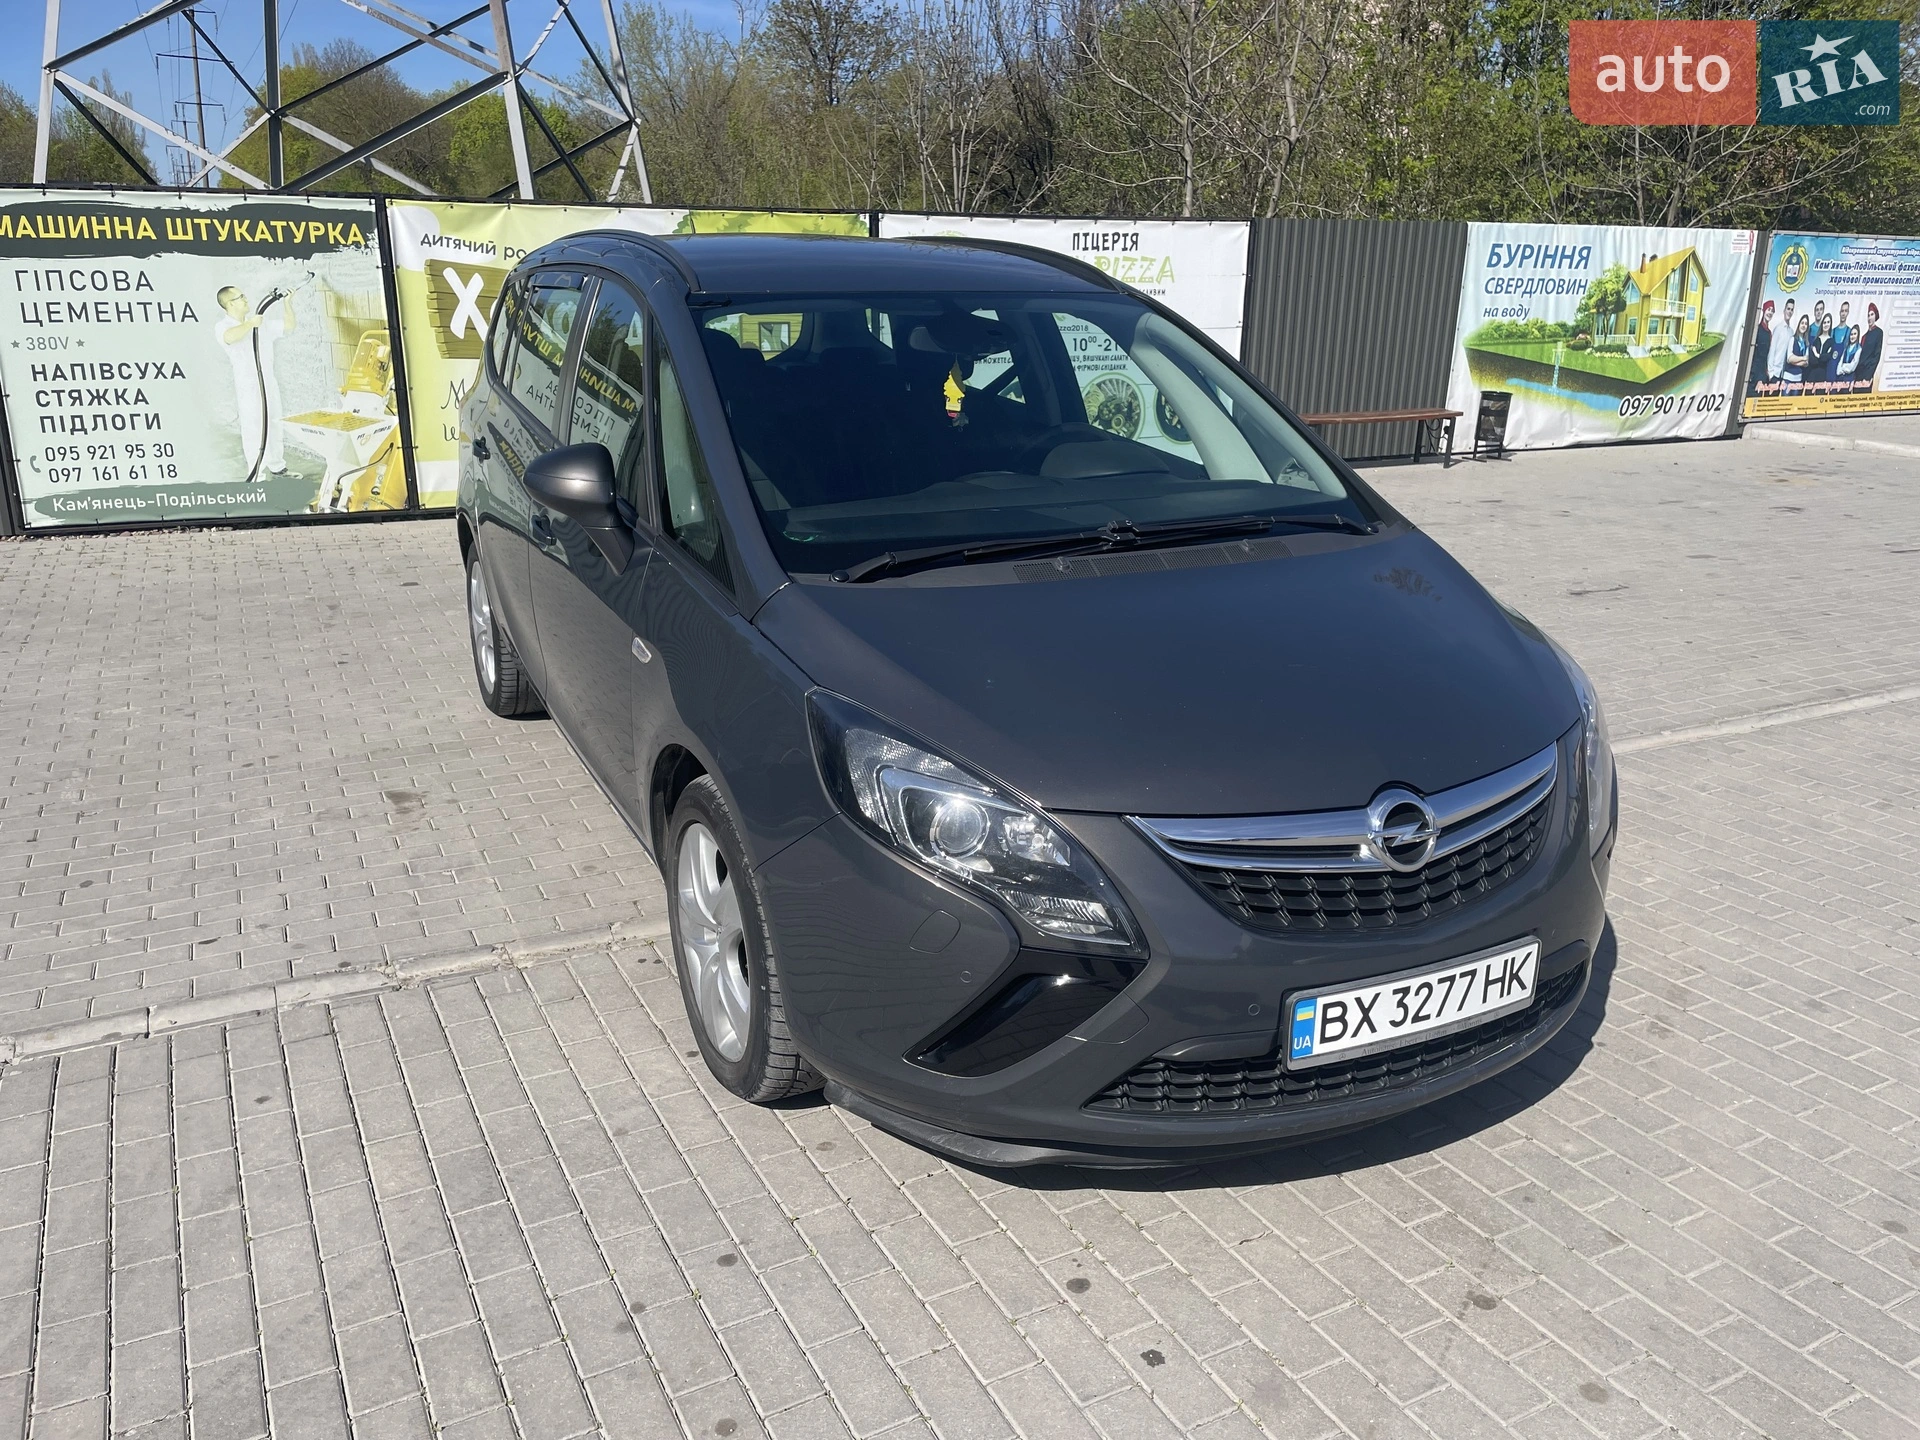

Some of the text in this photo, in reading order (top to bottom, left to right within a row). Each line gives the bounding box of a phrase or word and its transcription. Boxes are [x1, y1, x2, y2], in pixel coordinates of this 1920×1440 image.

[165, 217, 366, 246] ШТУКАТУРКА
[1072, 231, 1140, 252] ПІЦЕРІЯ
[420, 233, 528, 261] дитячий ро
[1487, 242, 1592, 270] БУРІННЯ
[14, 269, 154, 293] ГІПСОВА
[1094, 255, 1175, 285] PIZZA
[1484, 277, 1588, 297] СВЕРДЛОВИН
[20, 301, 199, 328] ЦЕМЕНТНА
[1483, 306, 1531, 320] на воду
[25, 336, 70, 352] 380V
[30, 362, 187, 382] НАПІВСУХА
[34, 387, 150, 408] СТЯЖКА
[1618, 394, 1725, 417] 097 90 11 002
[38, 412, 163, 436] ПІДЛОГИ
[44, 443, 175, 462] 095 921 95 30
[48, 464, 178, 483] 097 161 61 18
[53, 487, 267, 513] Кам'янець-Подільський
[1388, 967, 1478, 1029] 3277
[1294, 1036, 1312, 1050] UA
